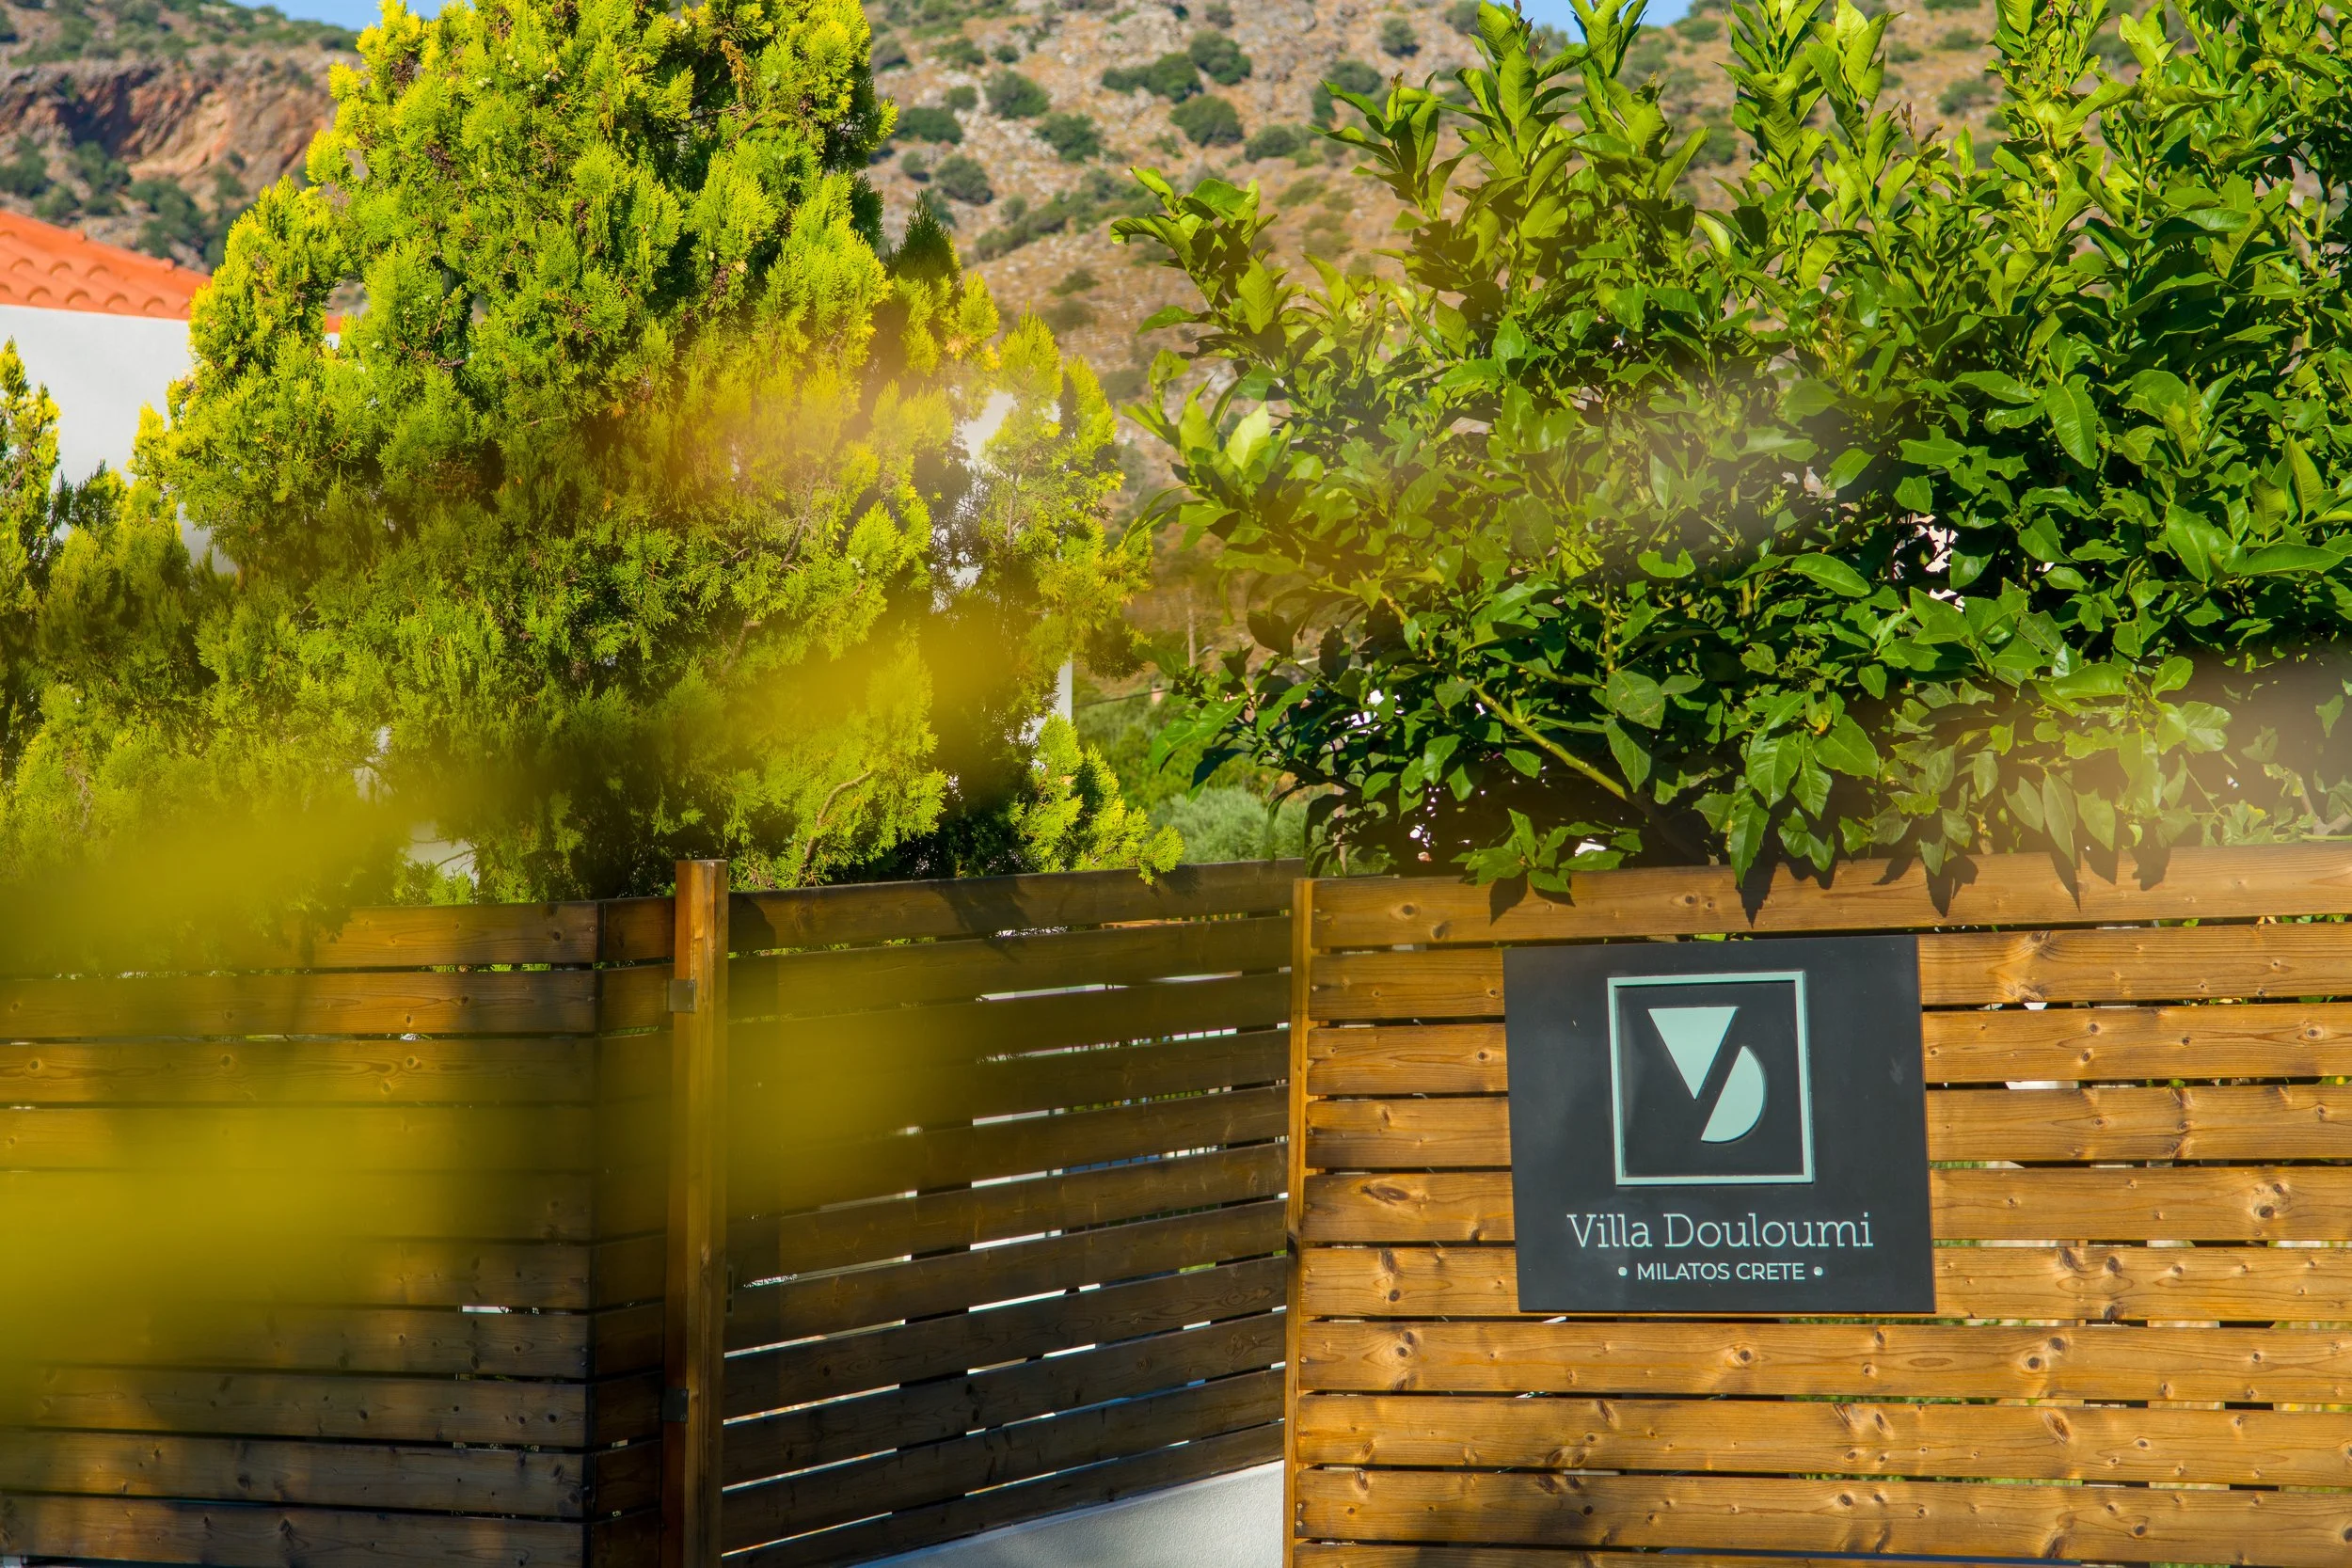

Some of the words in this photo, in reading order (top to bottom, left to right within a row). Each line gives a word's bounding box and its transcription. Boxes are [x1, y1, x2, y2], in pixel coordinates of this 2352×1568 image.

[1566, 1213, 1653, 1248] Villa
[1663, 1212, 1874, 1248] Douloumi
[1637, 1262, 1731, 1280] MILATOS
[1735, 1262, 1805, 1280] CRETE
